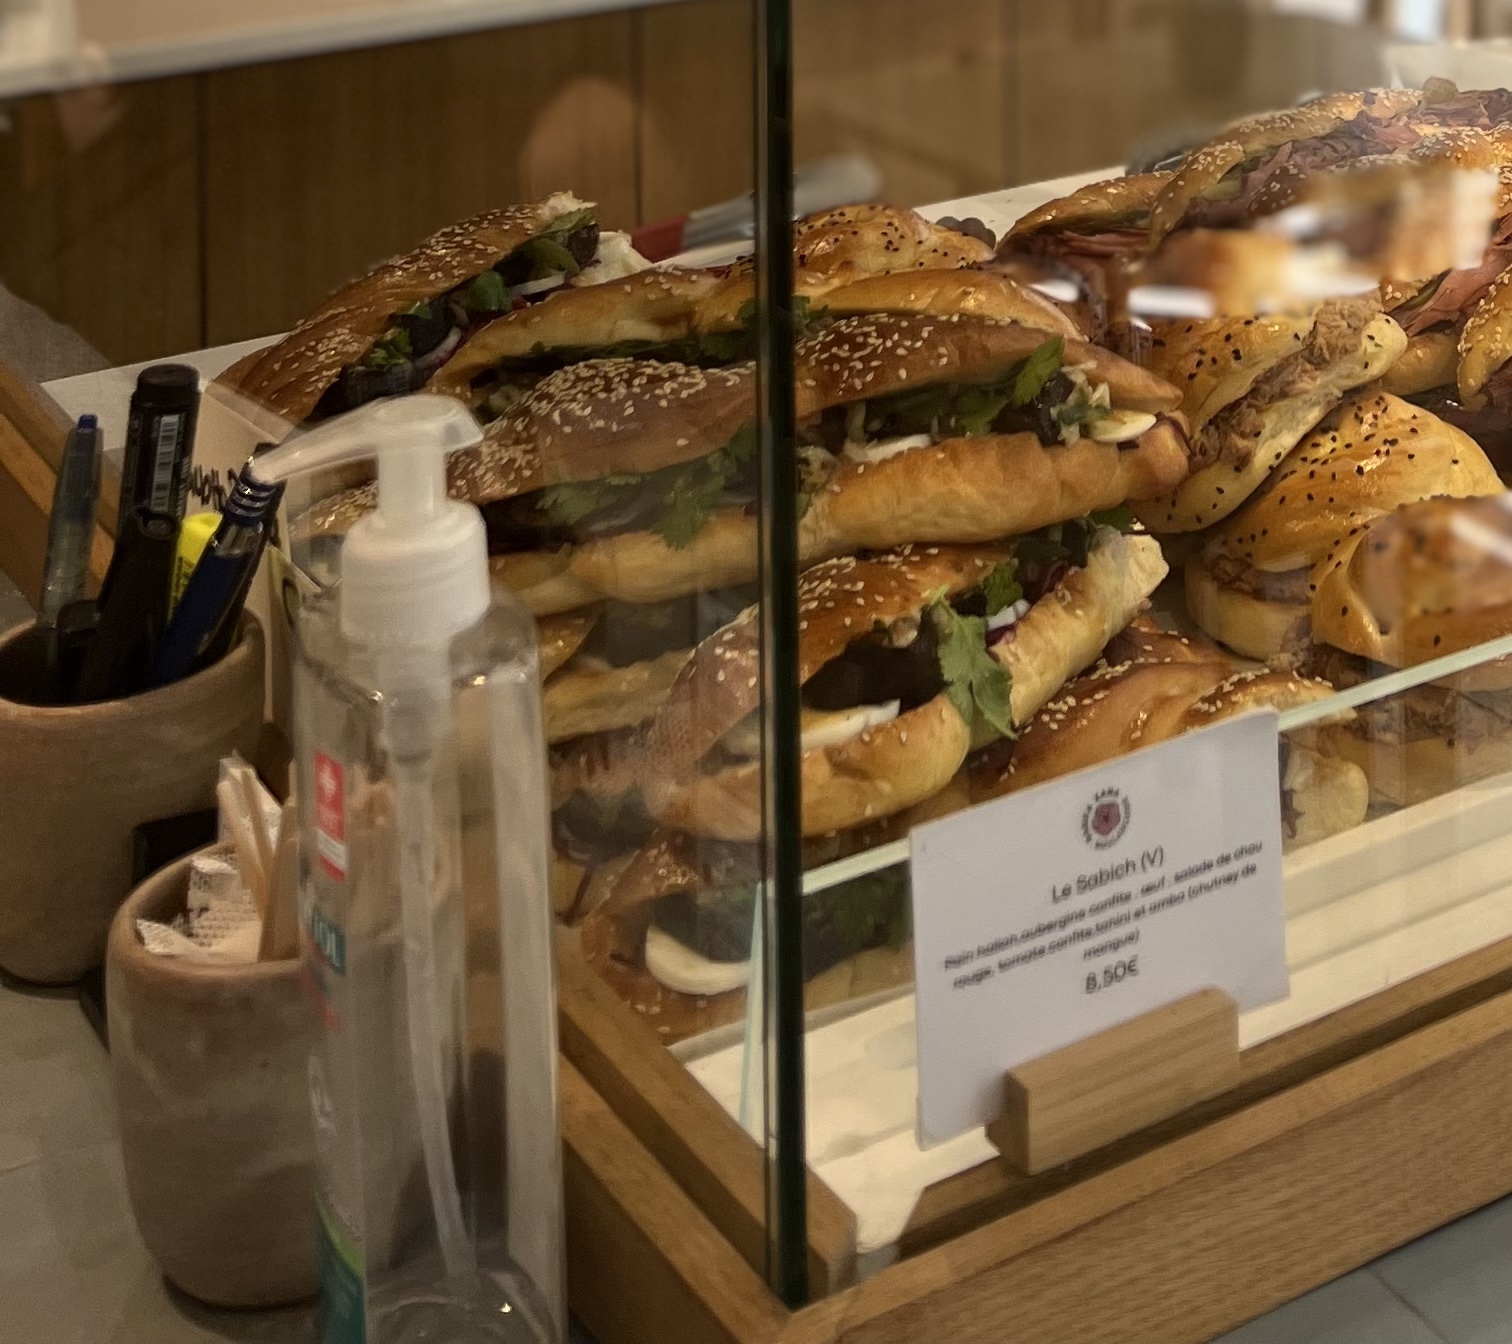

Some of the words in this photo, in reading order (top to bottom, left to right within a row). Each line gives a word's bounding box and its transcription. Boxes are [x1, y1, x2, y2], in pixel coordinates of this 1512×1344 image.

[1052, 882, 1072, 905] Le
[1076, 857, 1136, 895] Sabich
[1140, 844, 1165, 874] (V)
[1084, 953, 1140, 995] 8,50€
